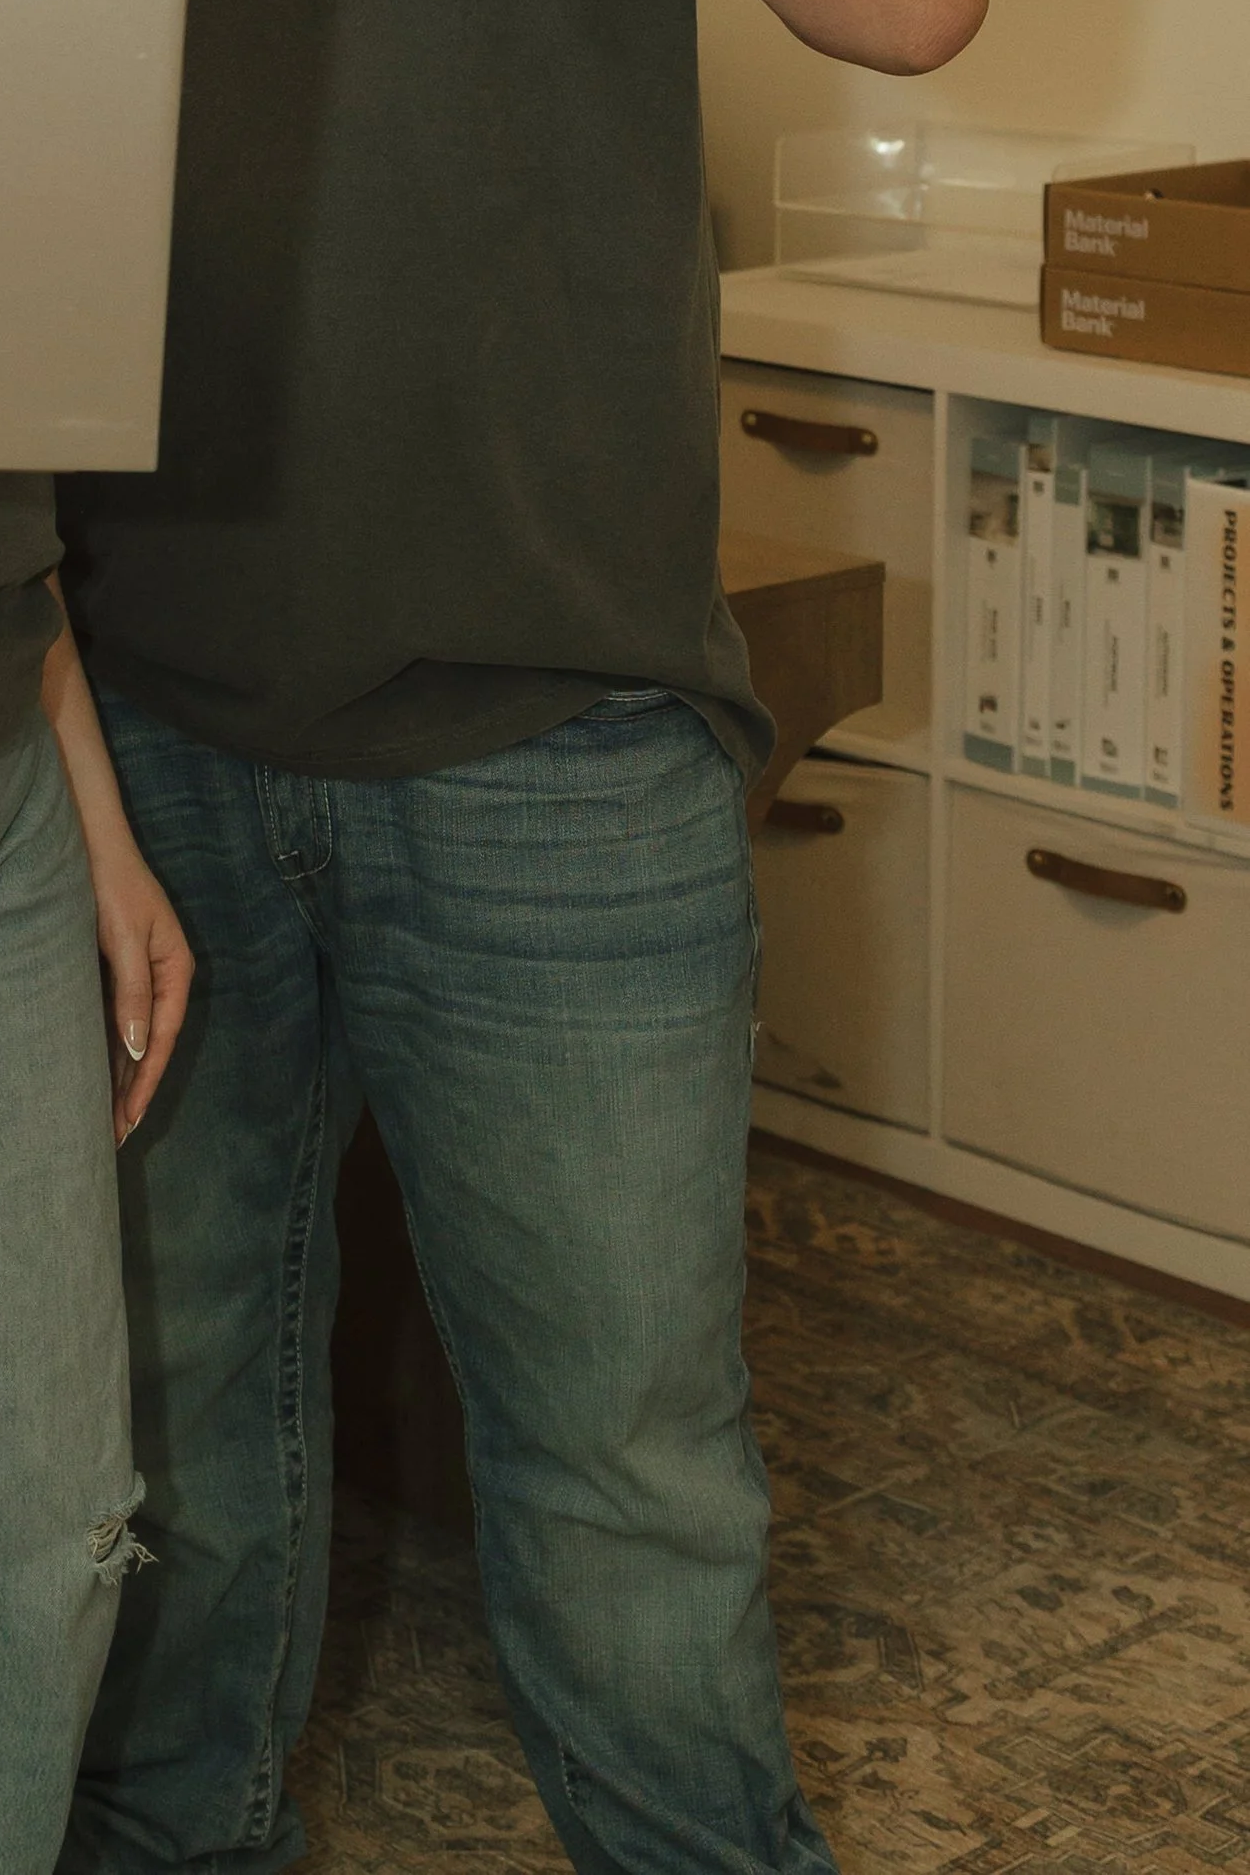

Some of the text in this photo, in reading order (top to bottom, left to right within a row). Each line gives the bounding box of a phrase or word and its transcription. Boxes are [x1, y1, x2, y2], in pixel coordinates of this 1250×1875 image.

[1064, 209, 1149, 239] Material
[1064, 232, 1116, 256] Bank
[1061, 289, 1145, 320] Material
[1061, 311, 1113, 336] Bank
[1219, 510, 1237, 811] PROJECTS & OPERATIONS
